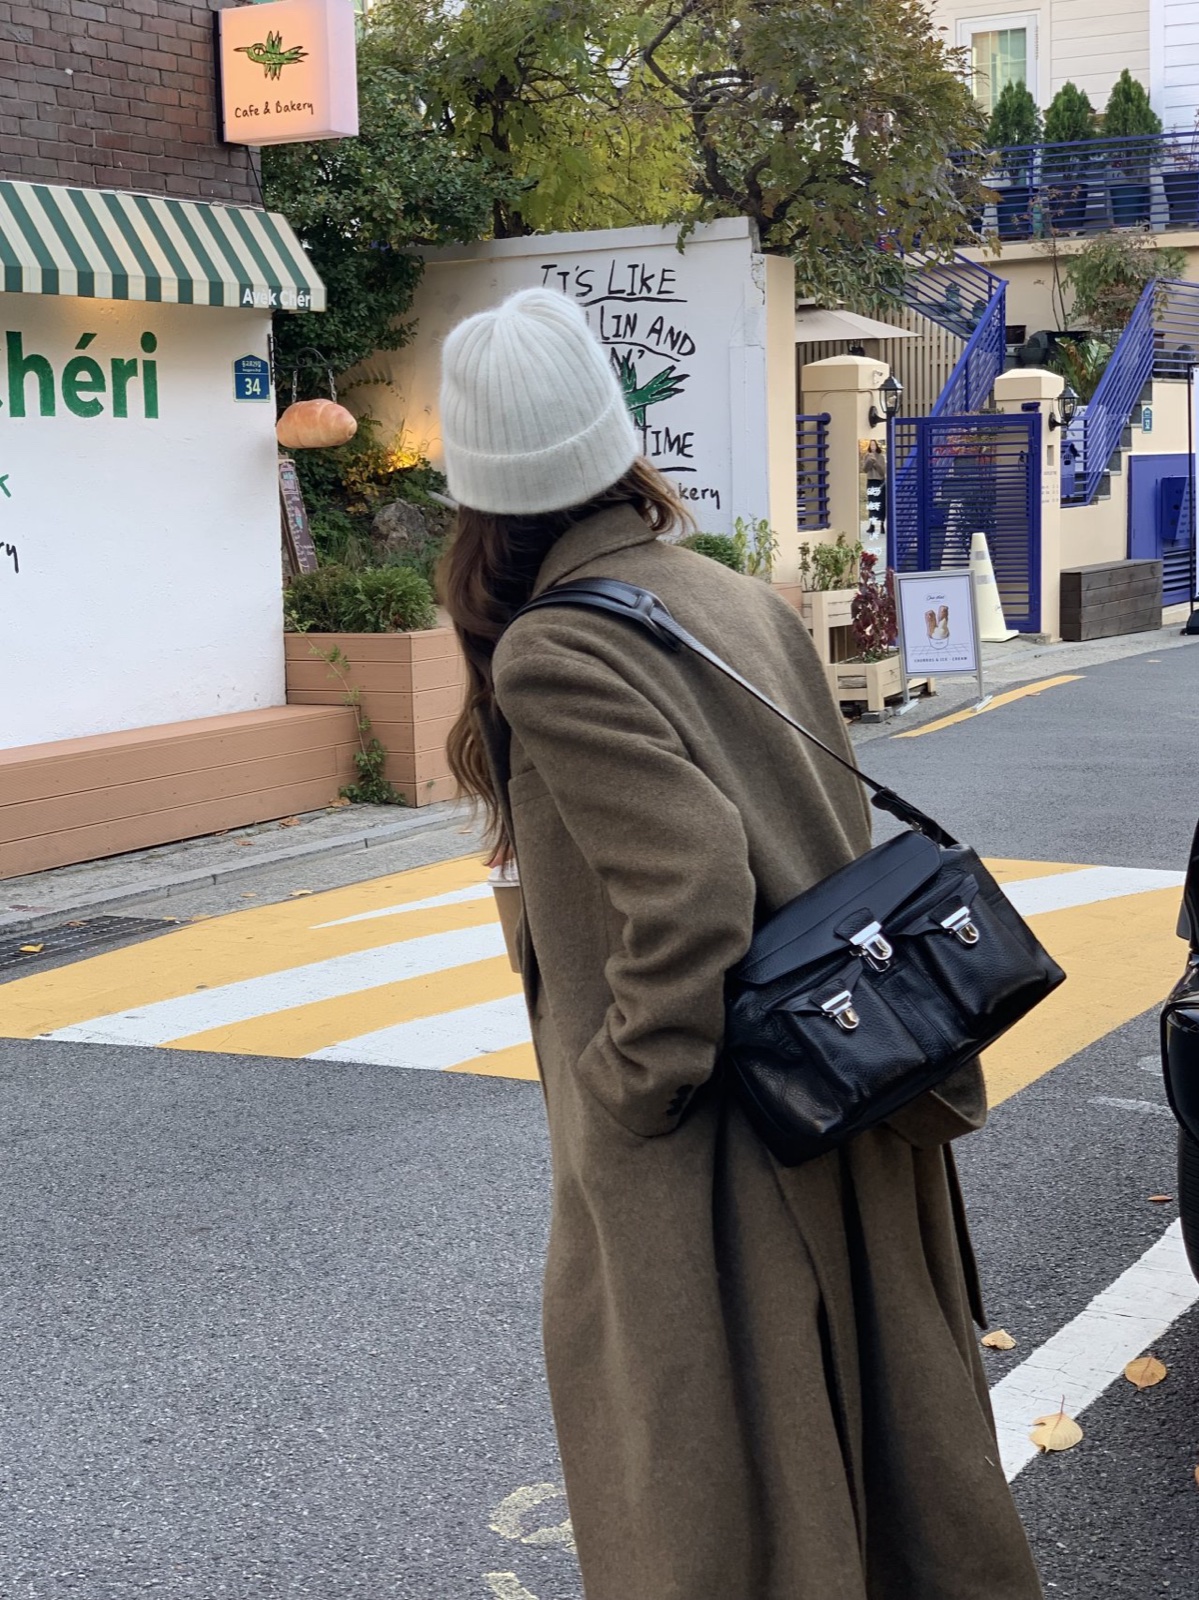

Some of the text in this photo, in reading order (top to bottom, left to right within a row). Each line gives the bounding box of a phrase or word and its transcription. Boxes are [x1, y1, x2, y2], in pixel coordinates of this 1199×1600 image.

[234, 100, 314, 118] Cafe & Bakery
[242, 287, 313, 308] Avèk Chéri
[646, 315, 696, 356] AND
[0, 330, 159, 419] héri
[244, 377, 261, 396] 34
[638, 425, 695, 458] TIME
